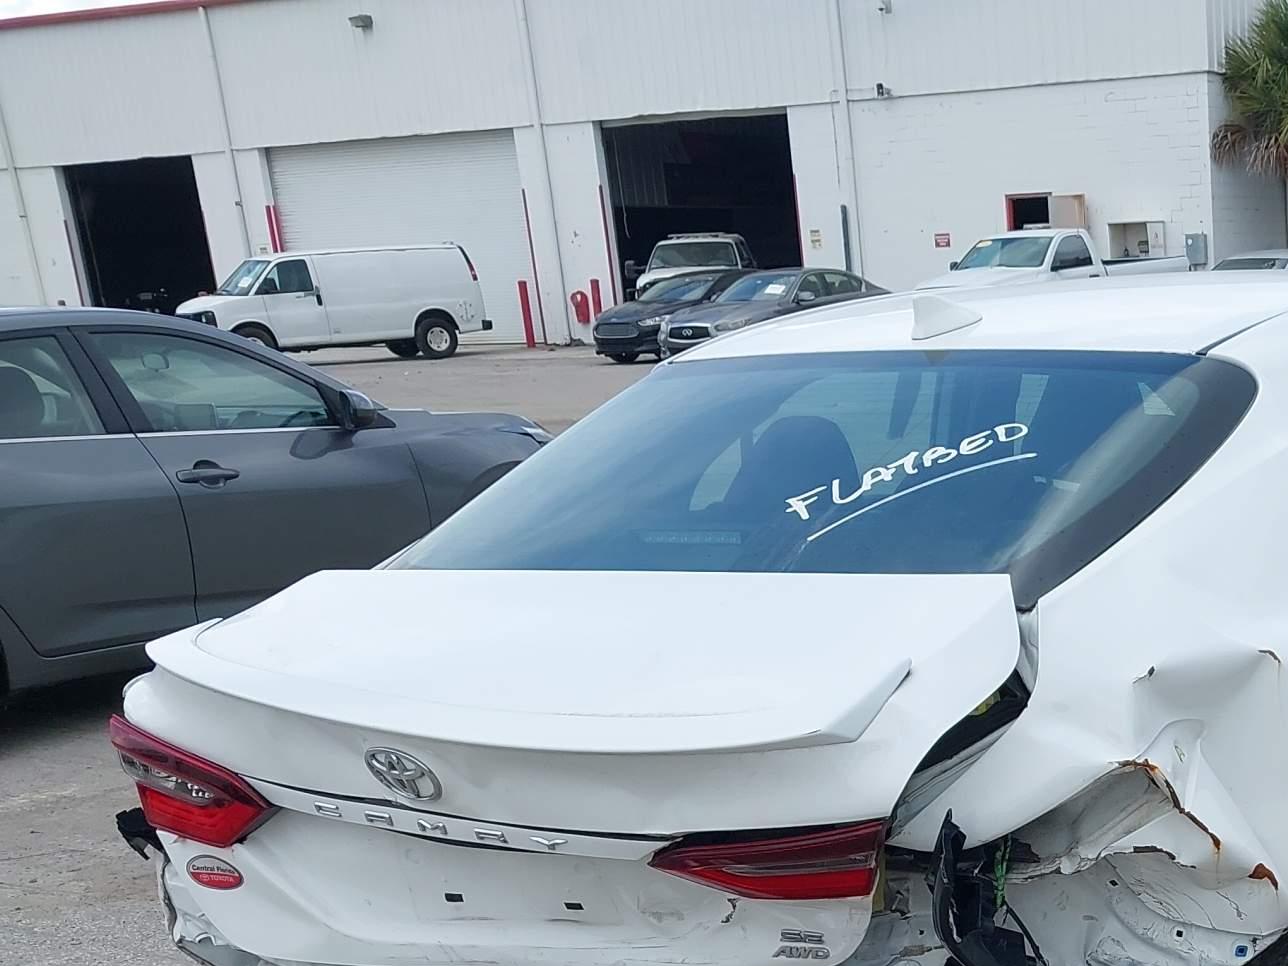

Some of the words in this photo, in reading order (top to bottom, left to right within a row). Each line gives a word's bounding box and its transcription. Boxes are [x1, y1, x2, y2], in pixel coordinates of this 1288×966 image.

[785, 423, 1029, 520] FLATBED
[314, 802, 568, 850] CAMRY
[191, 864, 215, 872] Central
[209, 874, 234, 882] TOYOTA
[780, 929, 825, 944] SE
[771, 945, 831, 960] AWD
